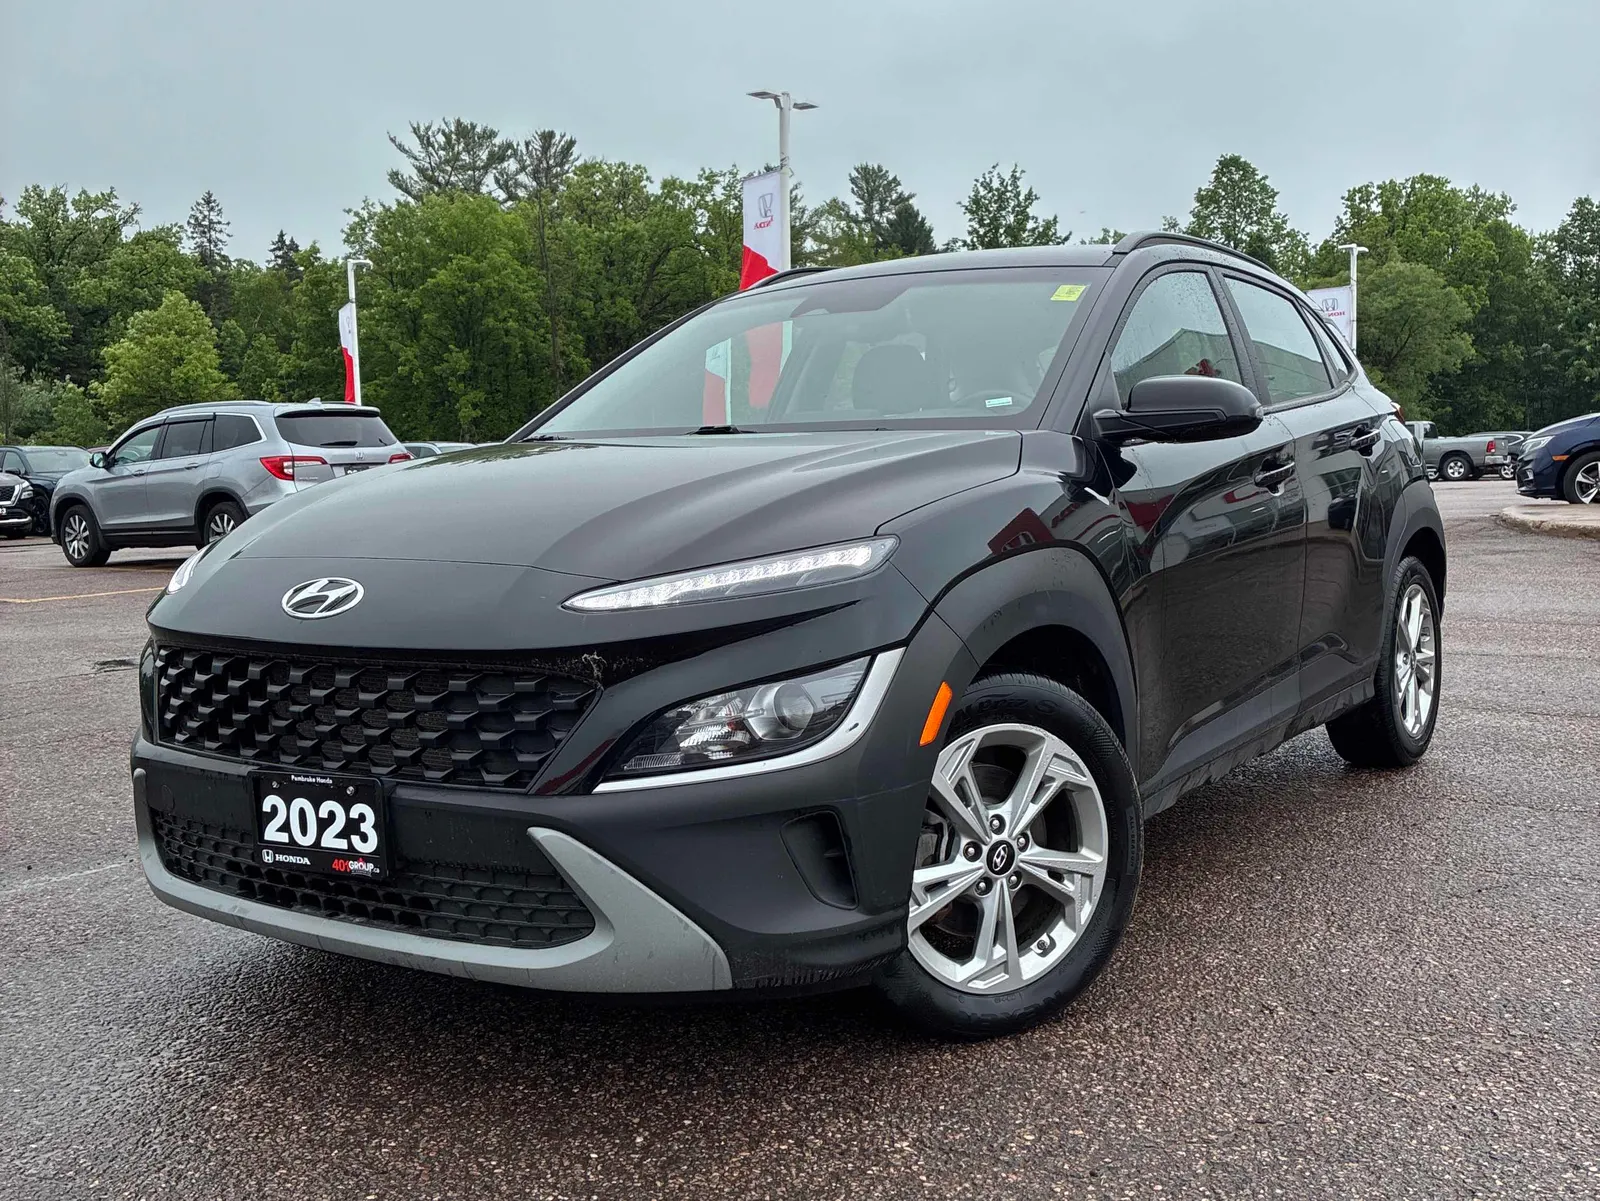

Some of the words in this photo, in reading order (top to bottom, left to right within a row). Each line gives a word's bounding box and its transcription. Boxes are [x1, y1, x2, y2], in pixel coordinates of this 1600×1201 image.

[291, 775, 315, 783] Pembroke
[316, 776, 332, 784] Honda
[262, 795, 378, 853] 2023
[276, 854, 310, 864] HONDA
